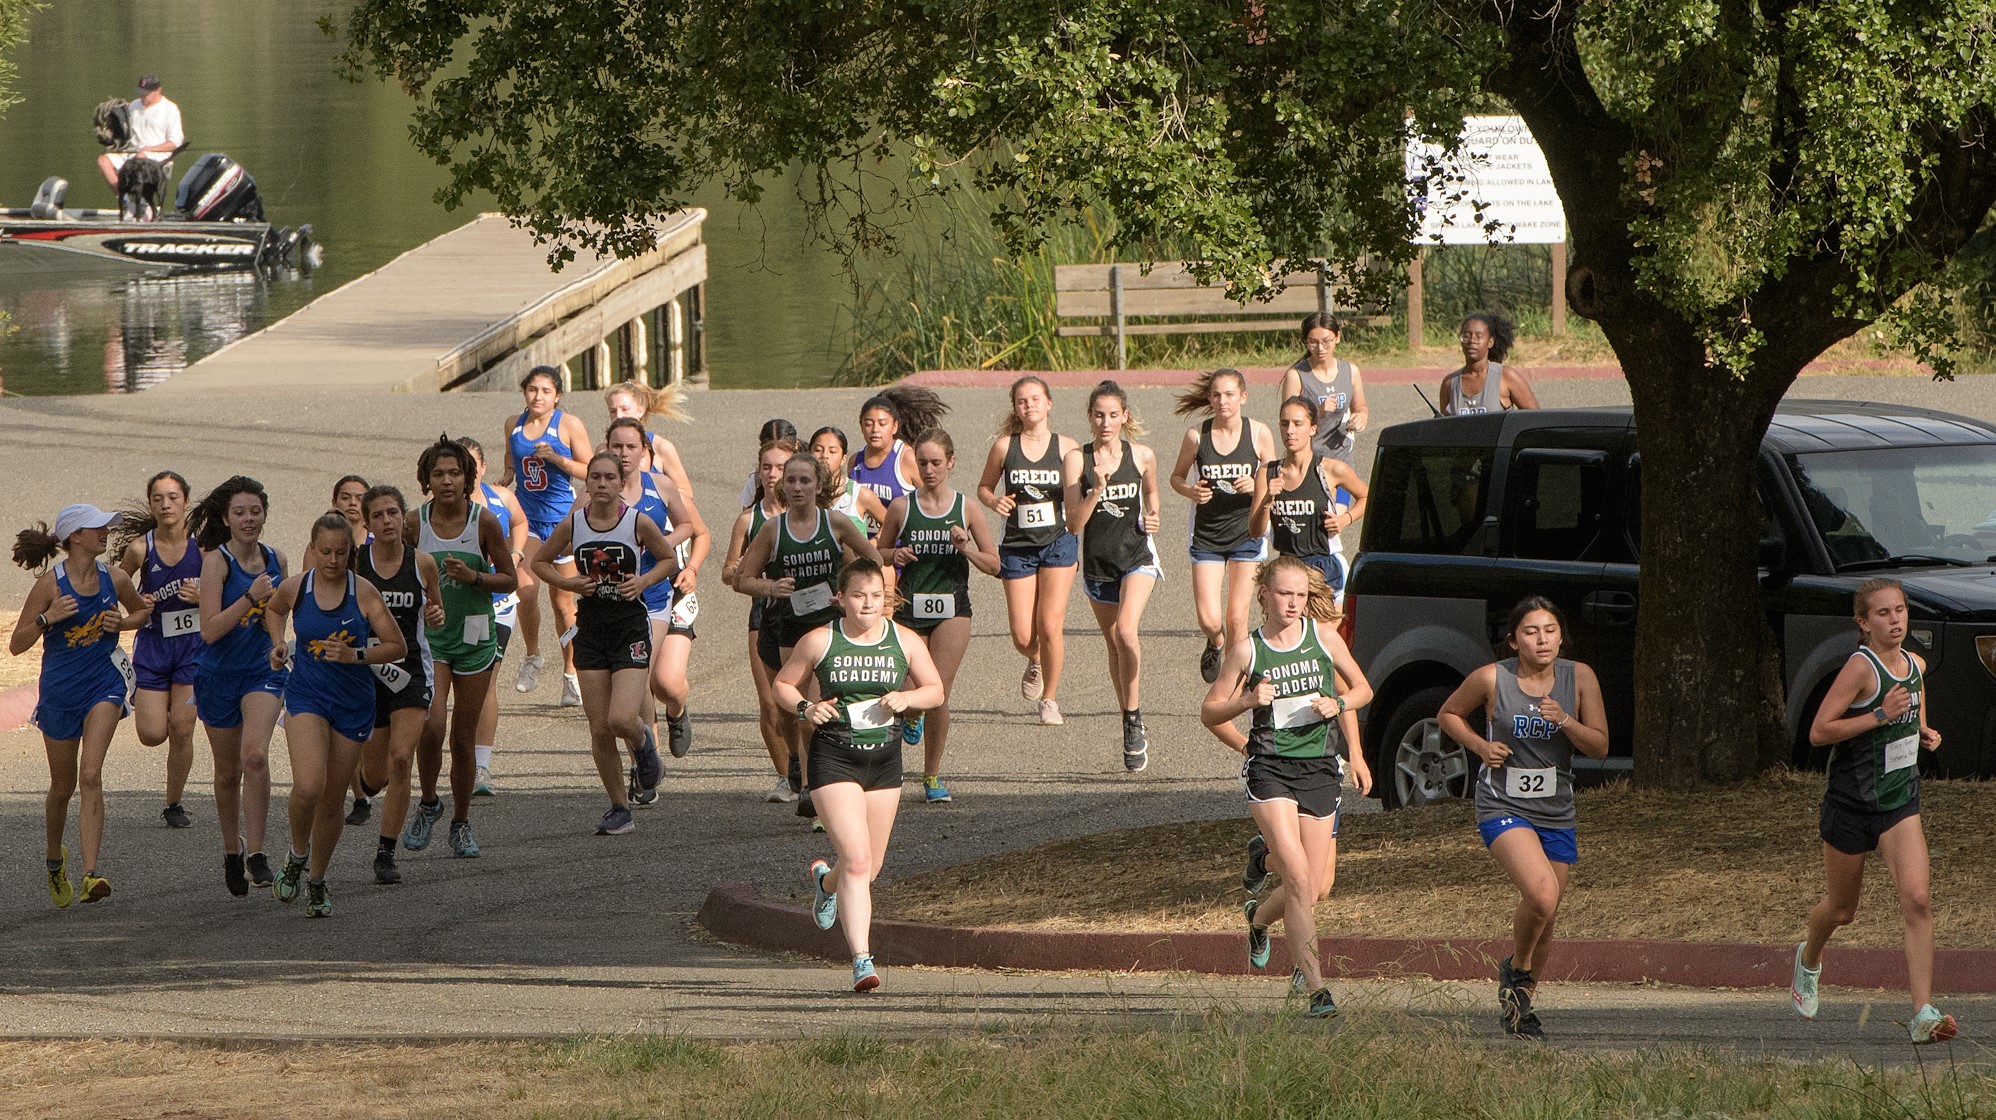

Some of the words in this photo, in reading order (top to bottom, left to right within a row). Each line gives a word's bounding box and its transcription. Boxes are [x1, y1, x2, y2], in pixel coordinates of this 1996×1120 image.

[1502, 137, 1516, 145] ON
[1486, 178, 1525, 186] ALLOWED
[124, 243, 255, 255] TRACKER
[1009, 469, 1060, 485] CREDO
[1201, 463, 1252, 479] CREDO
[1026, 508, 1045, 523] 51
[910, 529, 951, 542] SONOM
[783, 549, 830, 566] SONOMA
[784, 562, 833, 578] ACADEMY
[381, 590, 415, 609] EDO
[924, 598, 945, 614] 80
[174, 614, 193, 631] 16
[833, 655, 895, 669] SONOMA
[1263, 658, 1320, 682] SONOMA
[829, 669, 898, 684] ACADEMY
[1273, 674, 1324, 698] CADEMY
[1513, 714, 1559, 740] RCP
[1518, 774, 1545, 792] 32
